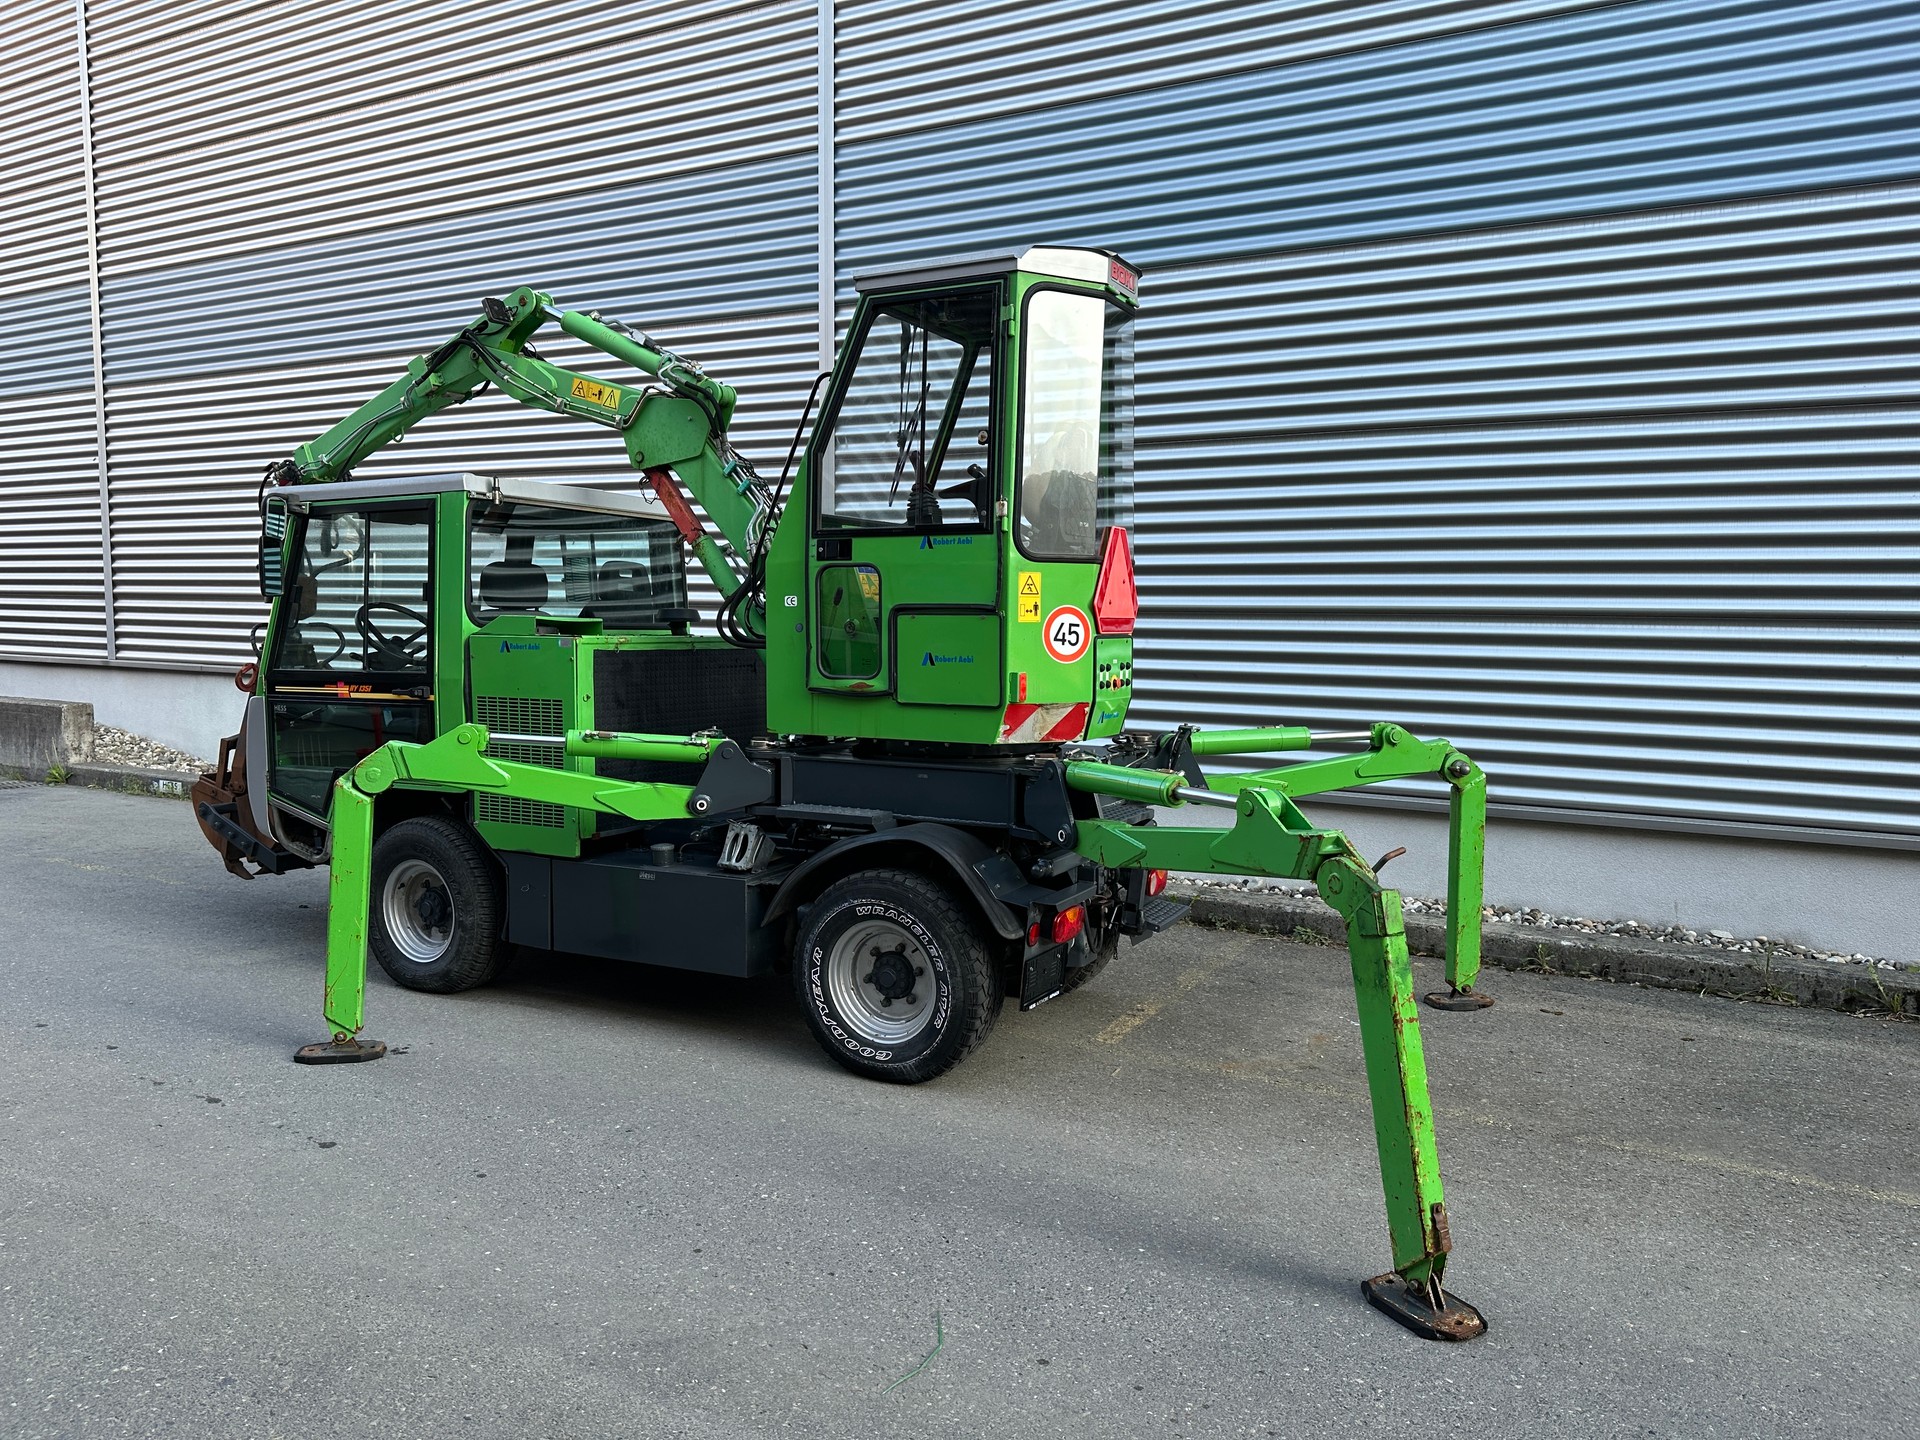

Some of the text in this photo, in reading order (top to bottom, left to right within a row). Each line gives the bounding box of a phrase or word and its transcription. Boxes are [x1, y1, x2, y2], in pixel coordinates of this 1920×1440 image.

[1111, 261, 1135, 291] BOKI
[932, 536, 973, 545] Robert Aebi
[786, 596, 796, 606] CE
[1053, 622, 1080, 647] 45
[934, 655, 974, 663] Robert Aebi
[856, 905, 948, 1029] WRANGLER AT/R
[811, 946, 893, 1061] GOODYEAR
